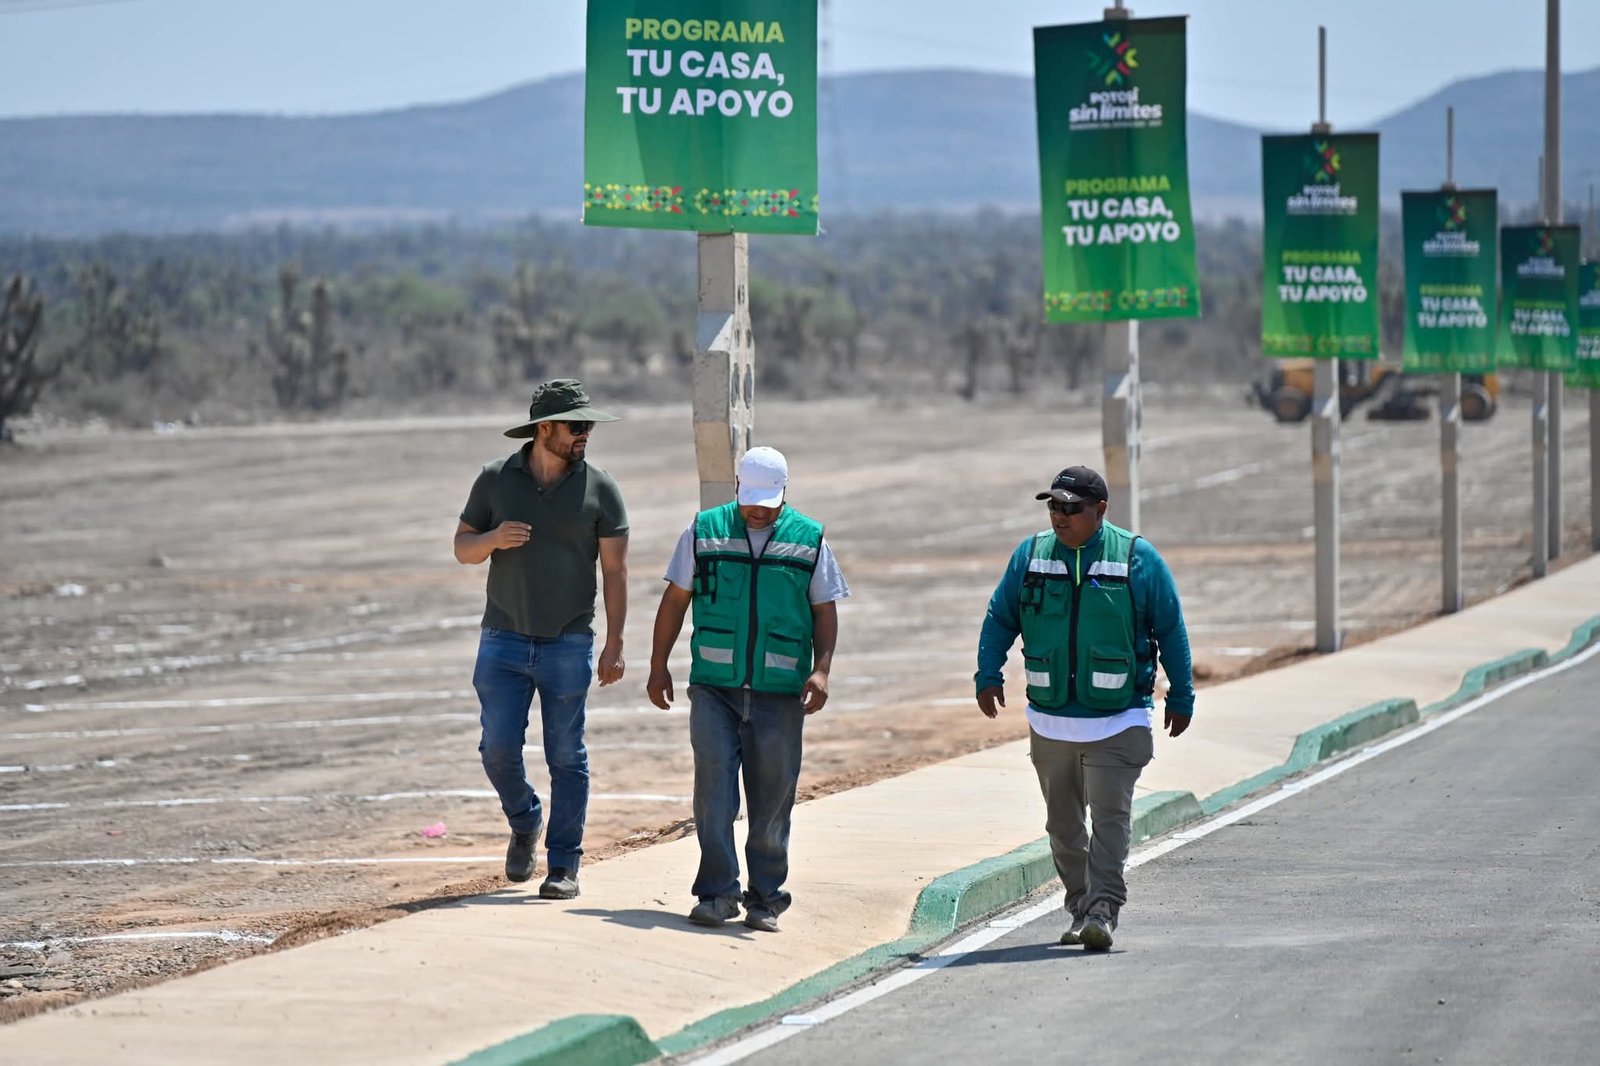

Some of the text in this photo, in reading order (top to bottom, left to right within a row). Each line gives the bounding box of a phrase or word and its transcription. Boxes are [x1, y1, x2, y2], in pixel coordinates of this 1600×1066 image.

[625, 18, 785, 43] PROGRAMA
[627, 49, 785, 86] TU CASA,
[617, 87, 794, 118] TU APOYO
[1069, 103, 1098, 122] sin
[1066, 175, 1171, 195] PROGRAMA
[1068, 196, 1174, 220] TU CASA,
[1062, 221, 1181, 246] TU APOYO
[1283, 265, 1362, 284] TU CASA,
[1278, 284, 1367, 303] TU APOYO
[1421, 296, 1441, 312] TU
[1417, 312, 1488, 328] TU APOYO
